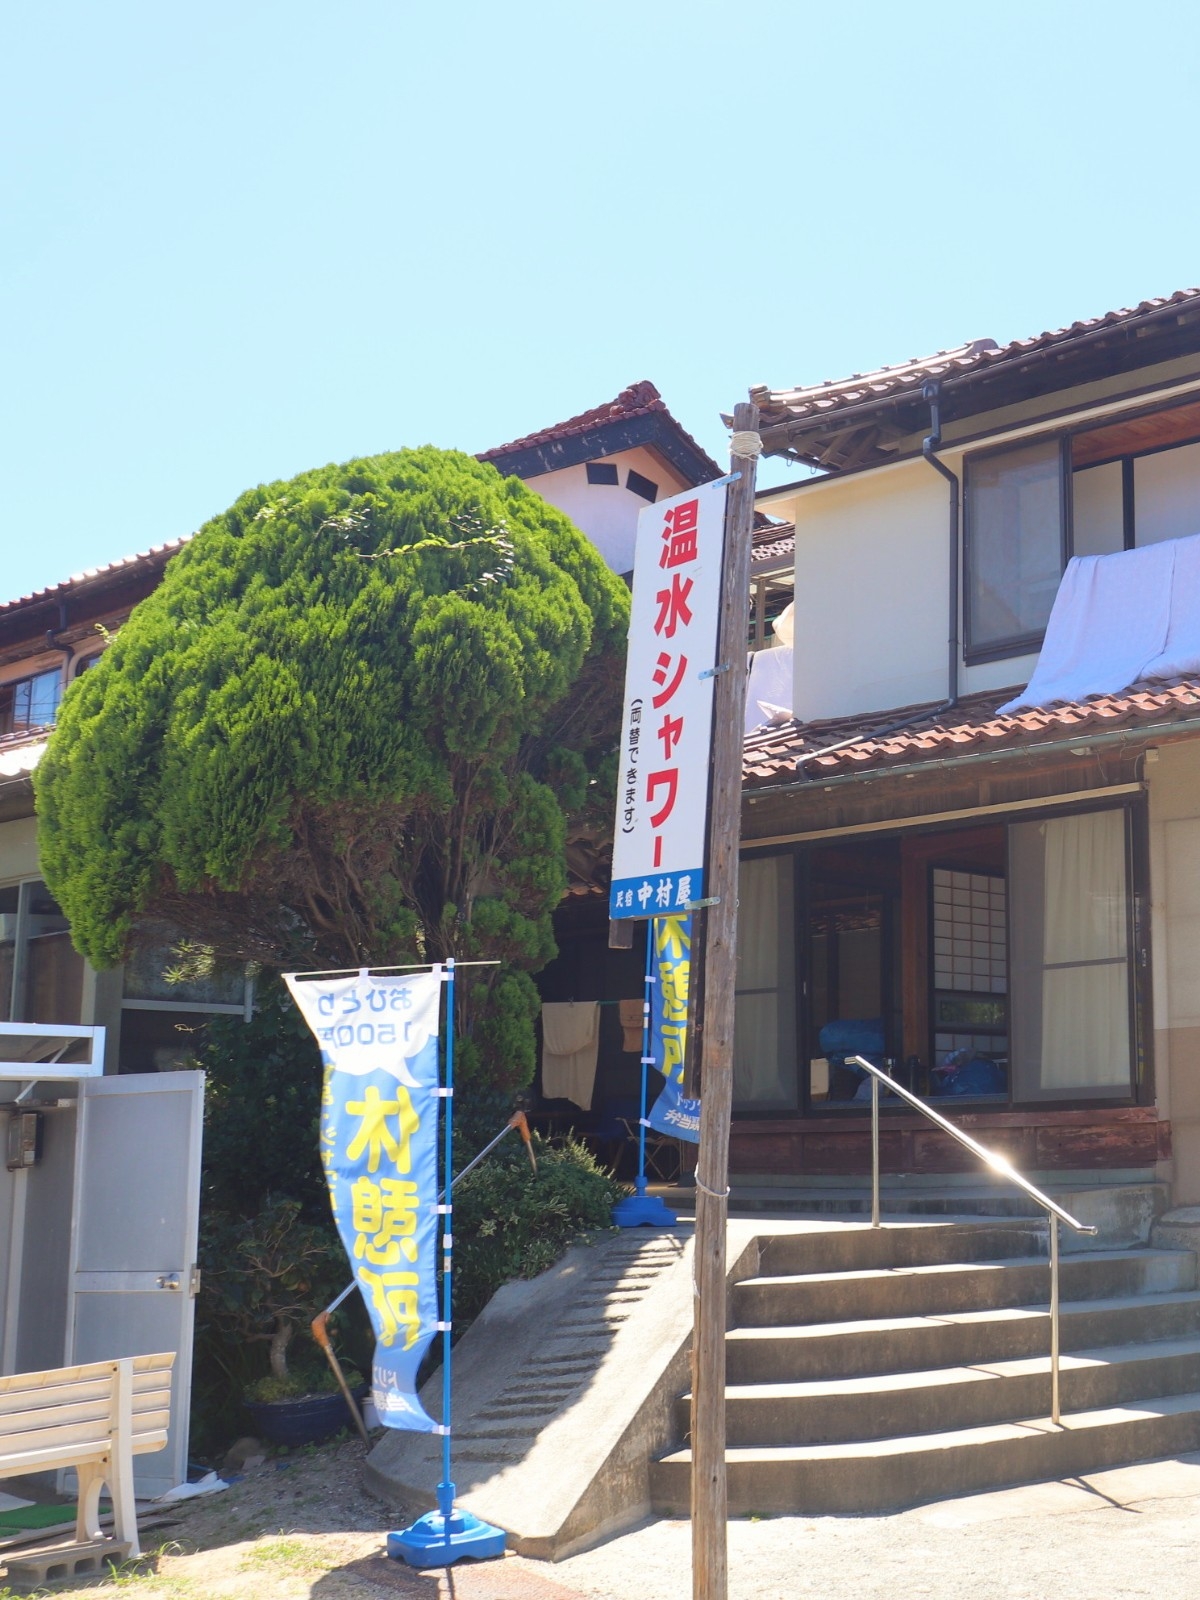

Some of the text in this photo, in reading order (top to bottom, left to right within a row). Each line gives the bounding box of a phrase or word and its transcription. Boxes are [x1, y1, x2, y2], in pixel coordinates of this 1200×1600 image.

[645, 498, 699, 868] 温水シャワー
[637, 874, 692, 910] 中村屋
